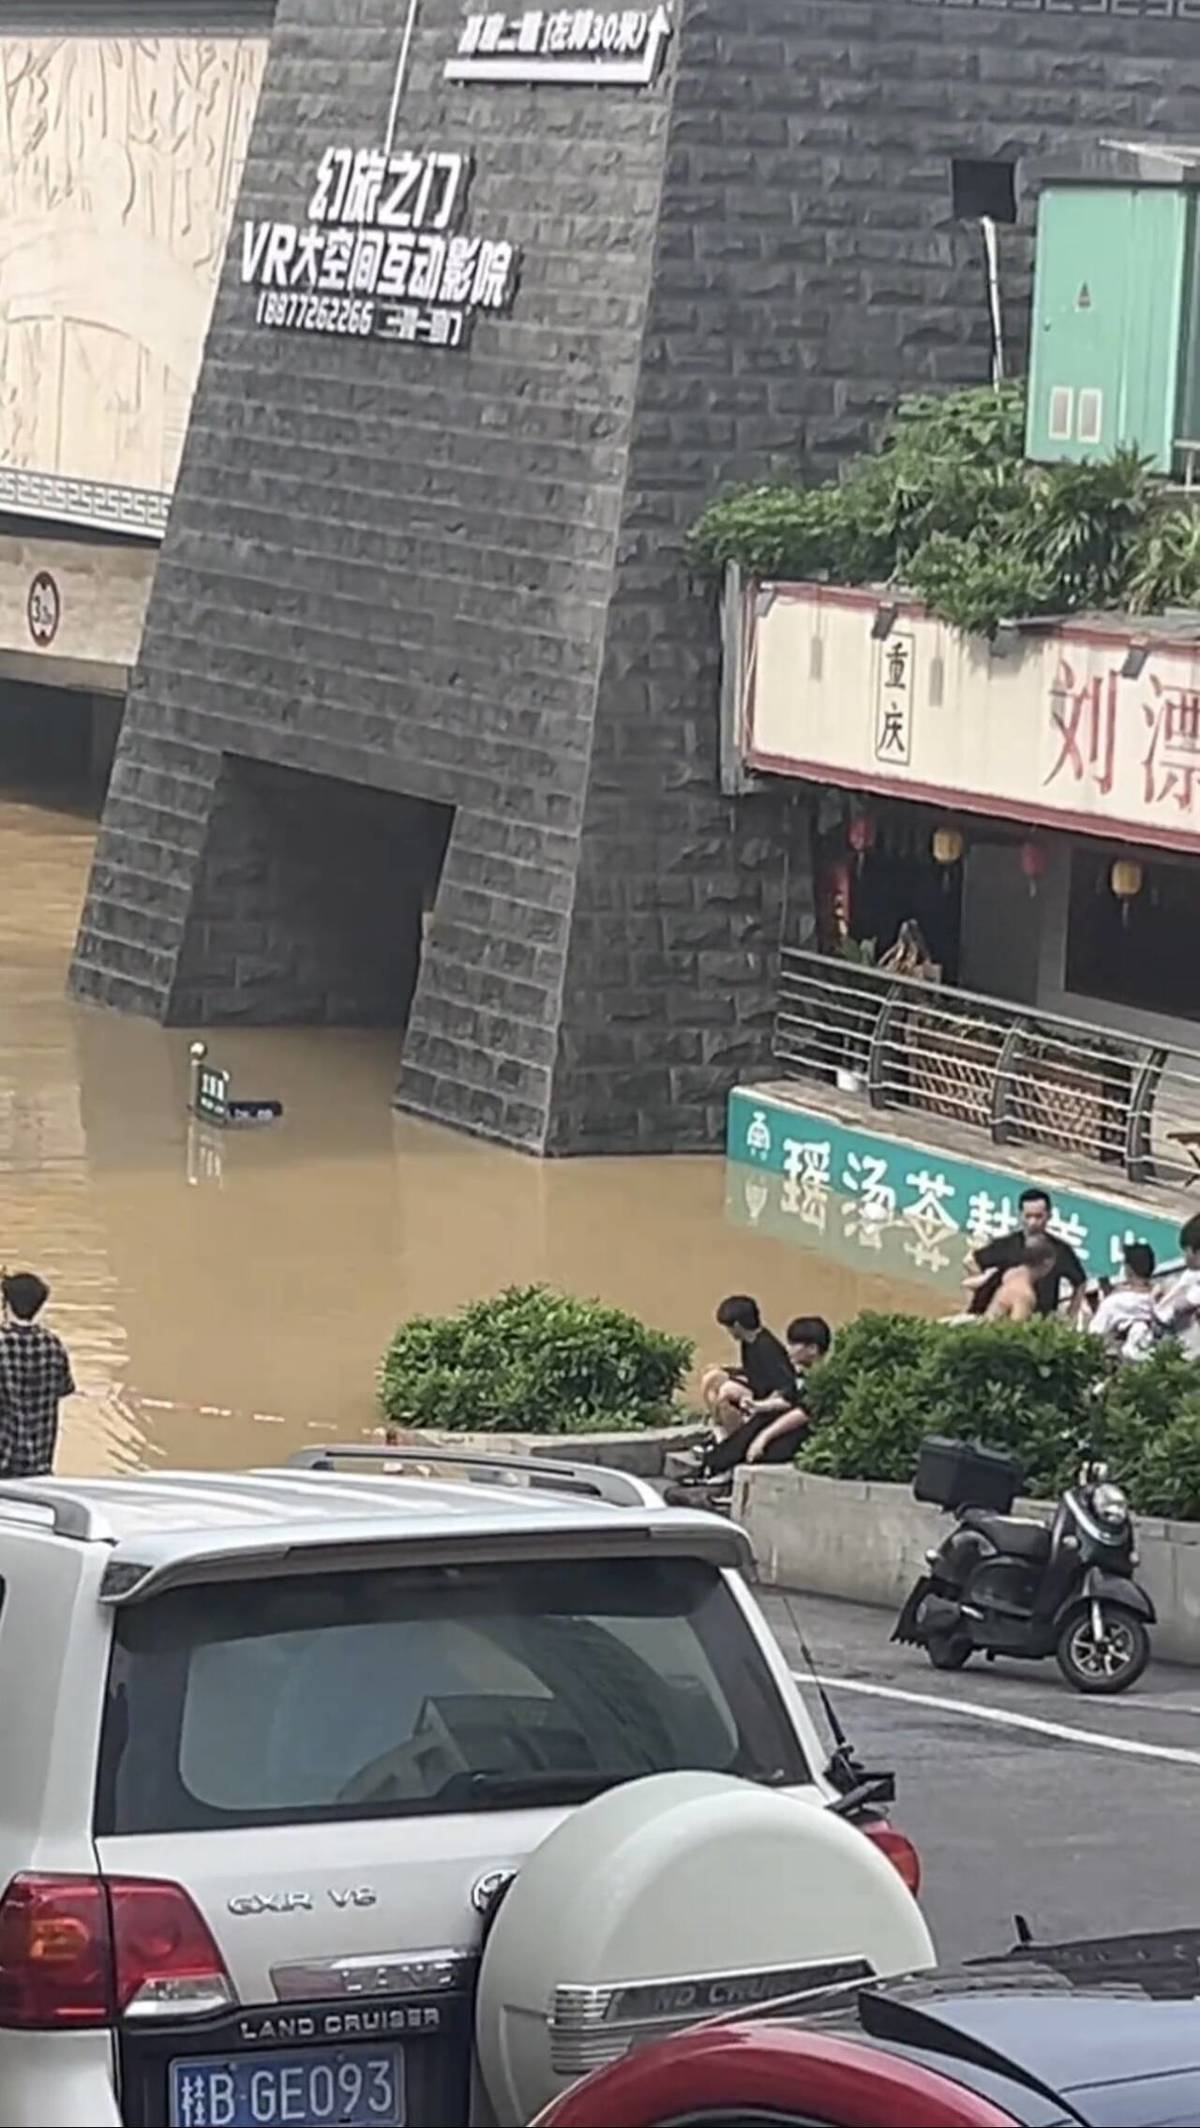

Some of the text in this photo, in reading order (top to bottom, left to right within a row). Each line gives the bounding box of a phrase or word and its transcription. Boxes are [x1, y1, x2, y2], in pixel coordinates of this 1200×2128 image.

[241, 221, 512, 307] VR大空间互动影院
[880, 642, 908, 752] 重庆
[227, 1891, 313, 1916] GXR
[240, 2007, 440, 2039] LAND CRUISER
